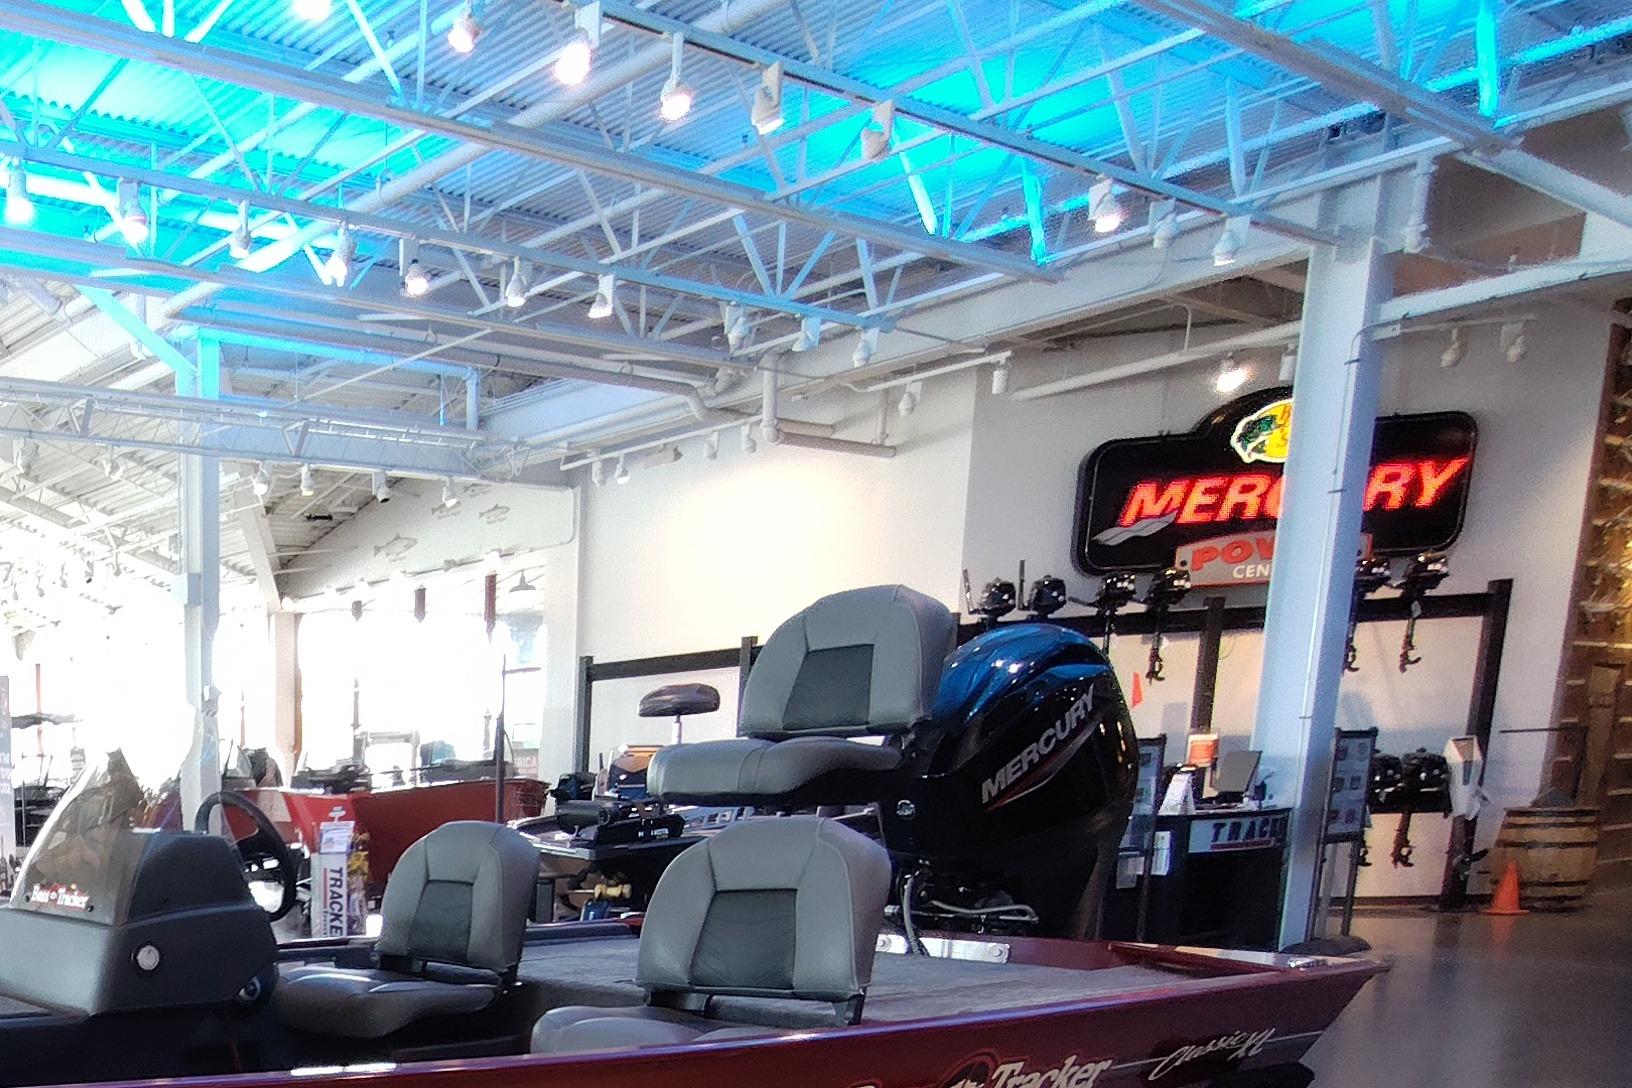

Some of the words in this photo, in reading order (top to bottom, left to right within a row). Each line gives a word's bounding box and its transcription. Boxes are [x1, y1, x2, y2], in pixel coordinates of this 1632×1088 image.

[1232, 563, 1271, 579] CEN
[981, 682, 1095, 804] MERCURY
[329, 866, 344, 937] TRACKE
